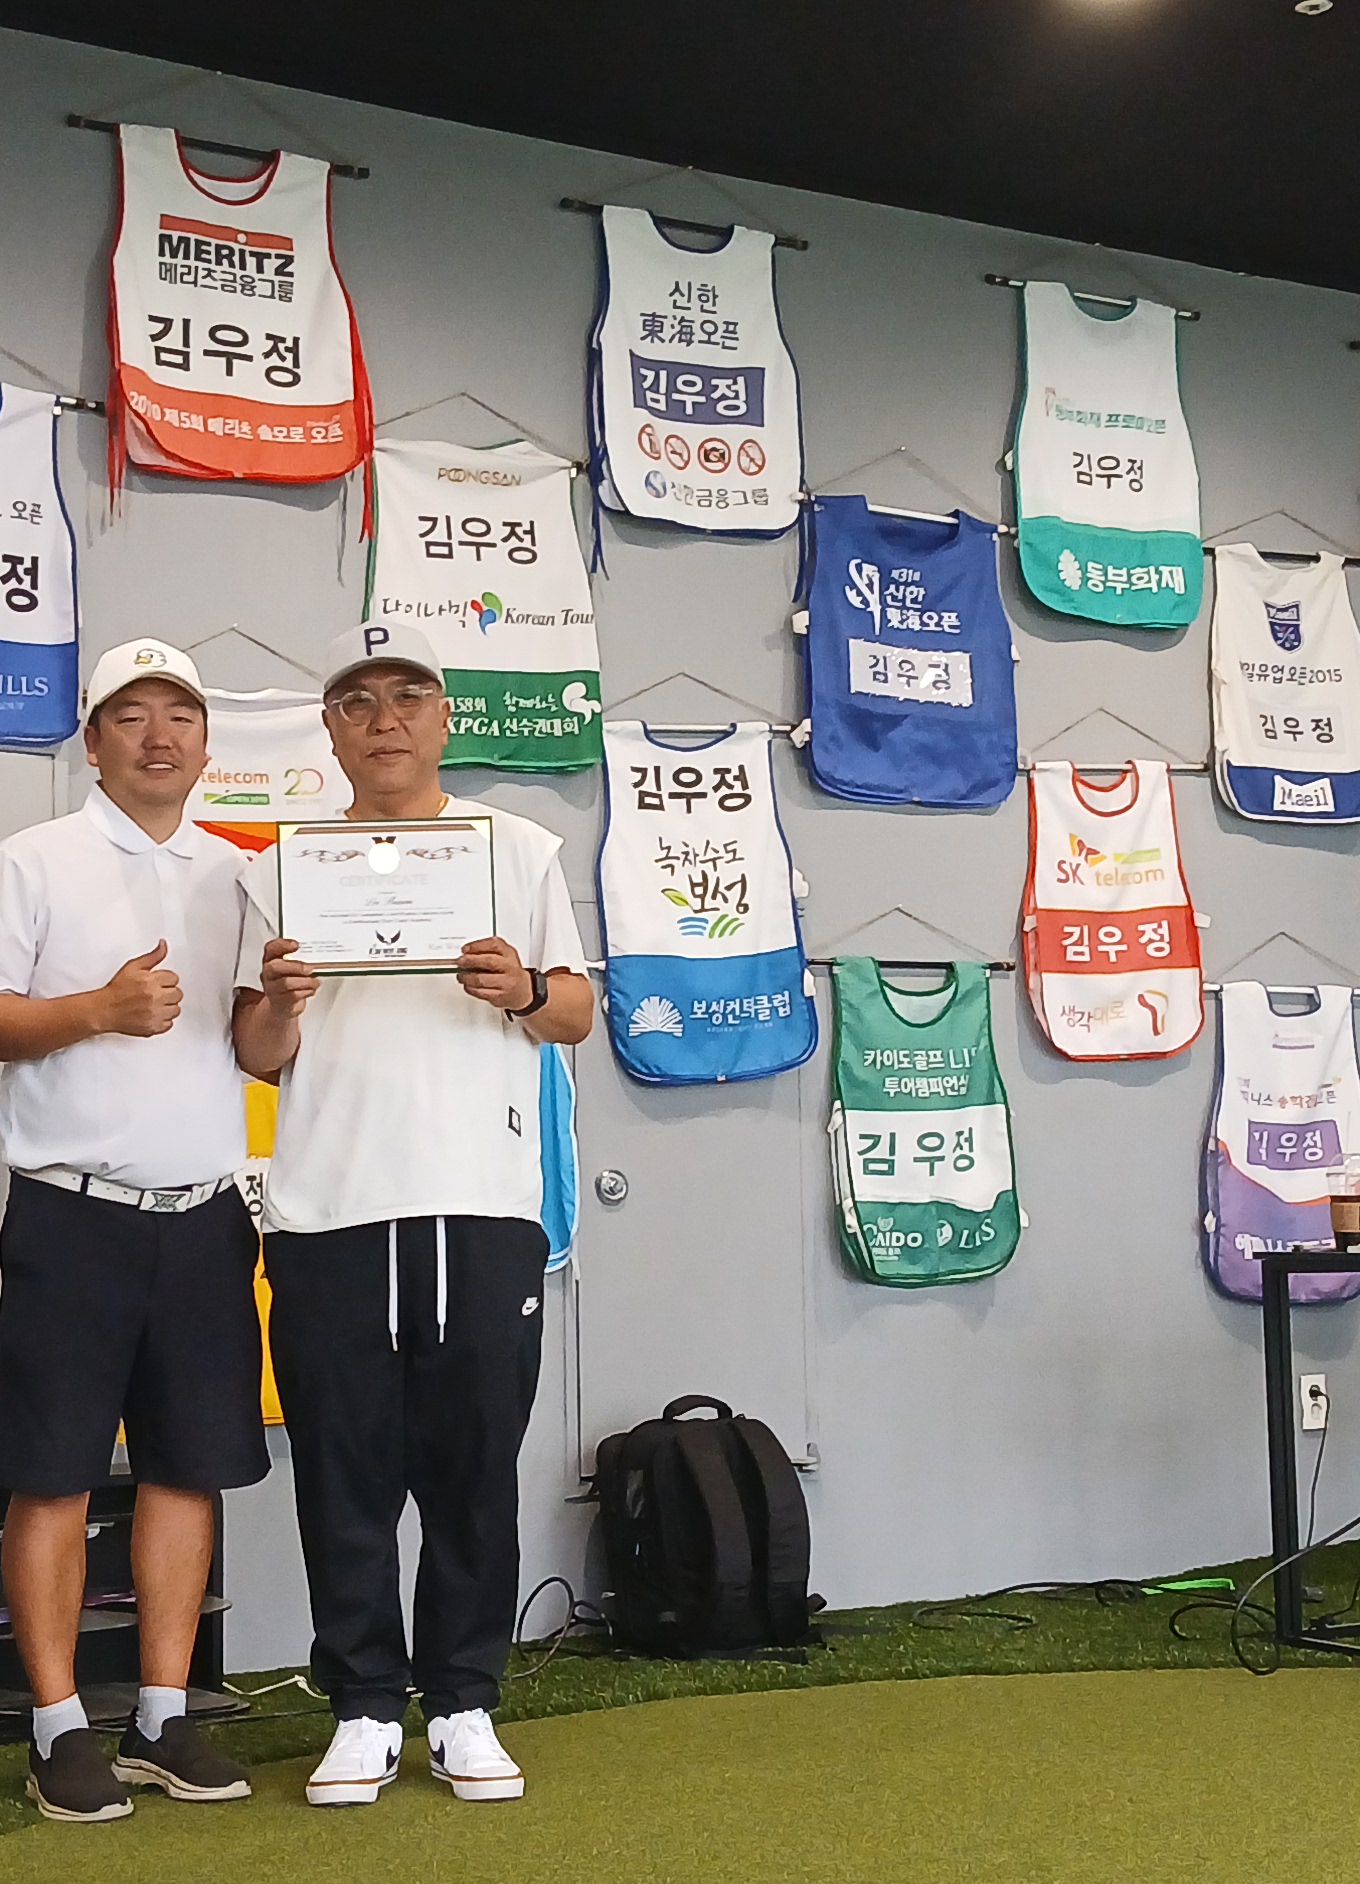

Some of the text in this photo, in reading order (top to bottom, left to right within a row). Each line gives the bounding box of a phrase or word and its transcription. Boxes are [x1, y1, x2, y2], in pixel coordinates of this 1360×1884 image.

[157, 233, 296, 279] MERITZ
[158, 262, 295, 303] 메리츠금융그룹
[669, 280, 719, 315] 신한
[640, 311, 741, 351] 東海오픈
[147, 314, 302, 388] 김우정
[639, 367, 749, 417] 김우정
[438, 467, 523, 487] POONGSAN
[1072, 451, 1145, 493] 김우정
[10, 500, 44, 526] 오픈
[417, 515, 539, 565] 김우정
[1085, 560, 1187, 595] 동부화재
[883, 584, 927, 609] 신한
[504, 607, 556, 627] Korean
[364, 627, 390, 657] P
[868, 654, 952, 691] 김우정
[447, 716, 501, 737] KPGA
[1258, 713, 1335, 744] 김우정
[201, 767, 270, 784] telecom
[630, 764, 752, 814] 김우정
[654, 835, 745, 878] 녹차수도
[1056, 859, 1165, 887] SK telecom
[687, 869, 750, 915] 보성
[1061, 919, 1171, 963] 김우정
[1060, 1001, 1127, 1034] 생각대로
[863, 1048, 946, 1071] 카이도골프
[857, 1126, 976, 1177] 김우정
[958, 1217, 996, 1249] LIS
